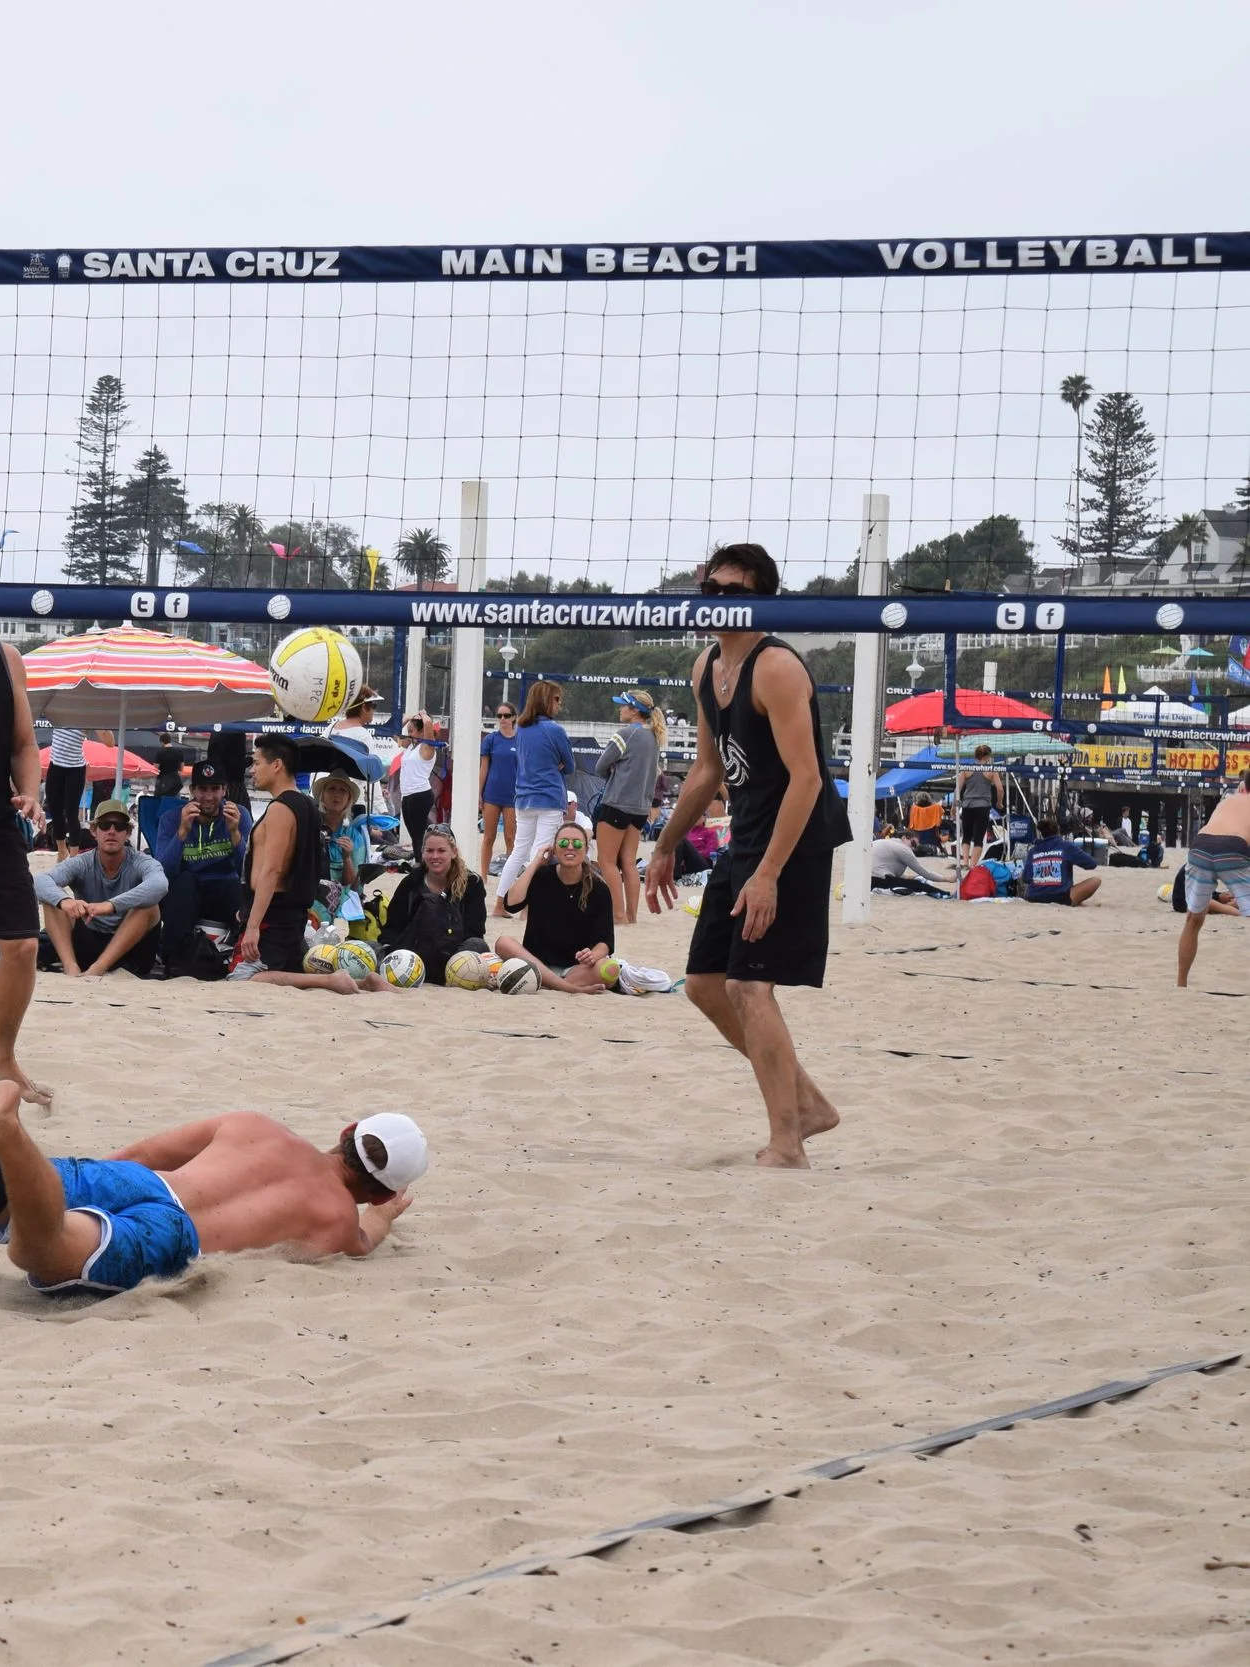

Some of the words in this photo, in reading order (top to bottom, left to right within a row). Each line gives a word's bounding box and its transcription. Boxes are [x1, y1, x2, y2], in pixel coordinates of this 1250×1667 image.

[84, 252, 214, 277] SANTA
[226, 251, 339, 276] CRUZ
[442, 249, 561, 274] MAIN
[587, 246, 756, 272] BEACH
[878, 238, 1220, 268] VOLLEYBALL
[412, 600, 752, 626] www.santacruzwharf.com
[582, 676, 611, 684] SANTA
[613, 677, 639, 685] CRUZ
[660, 679, 686, 687] MAIN
[887, 687, 913, 696] CRUZ
[1172, 713, 1193, 722] Dogs
[1105, 752, 1139, 768] WATER
[1169, 753, 1196, 769] HOT
